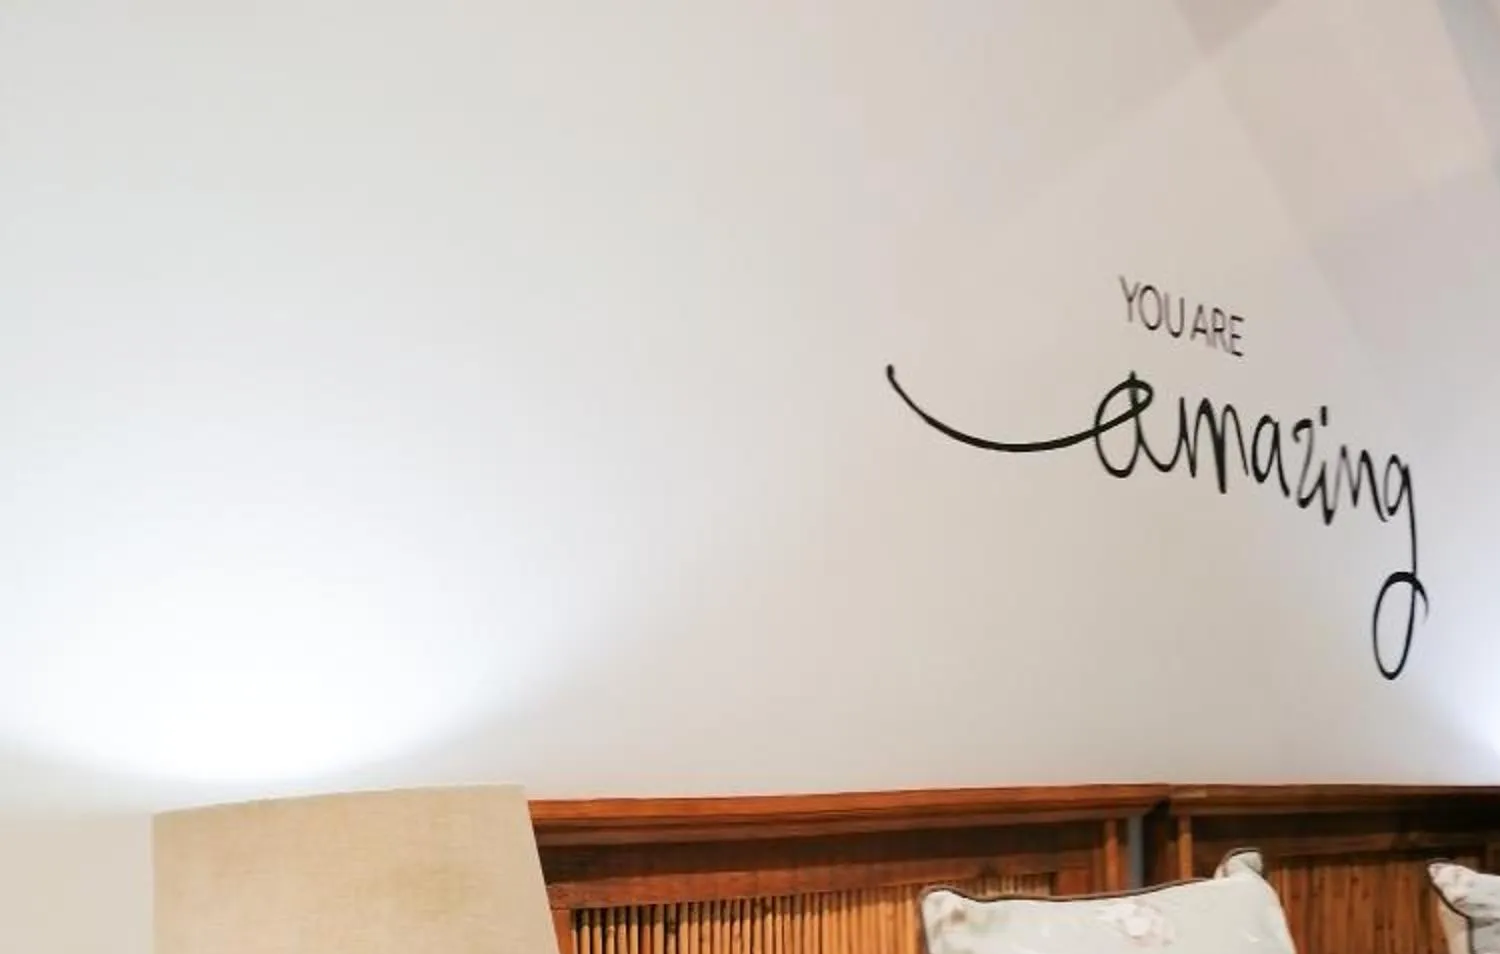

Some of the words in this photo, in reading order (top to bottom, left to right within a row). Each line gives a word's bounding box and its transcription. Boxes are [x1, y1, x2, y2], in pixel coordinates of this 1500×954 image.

[1119, 275, 1187, 339] YOU
[1190, 303, 1246, 358] ARE
[886, 364, 1430, 682] amazing
